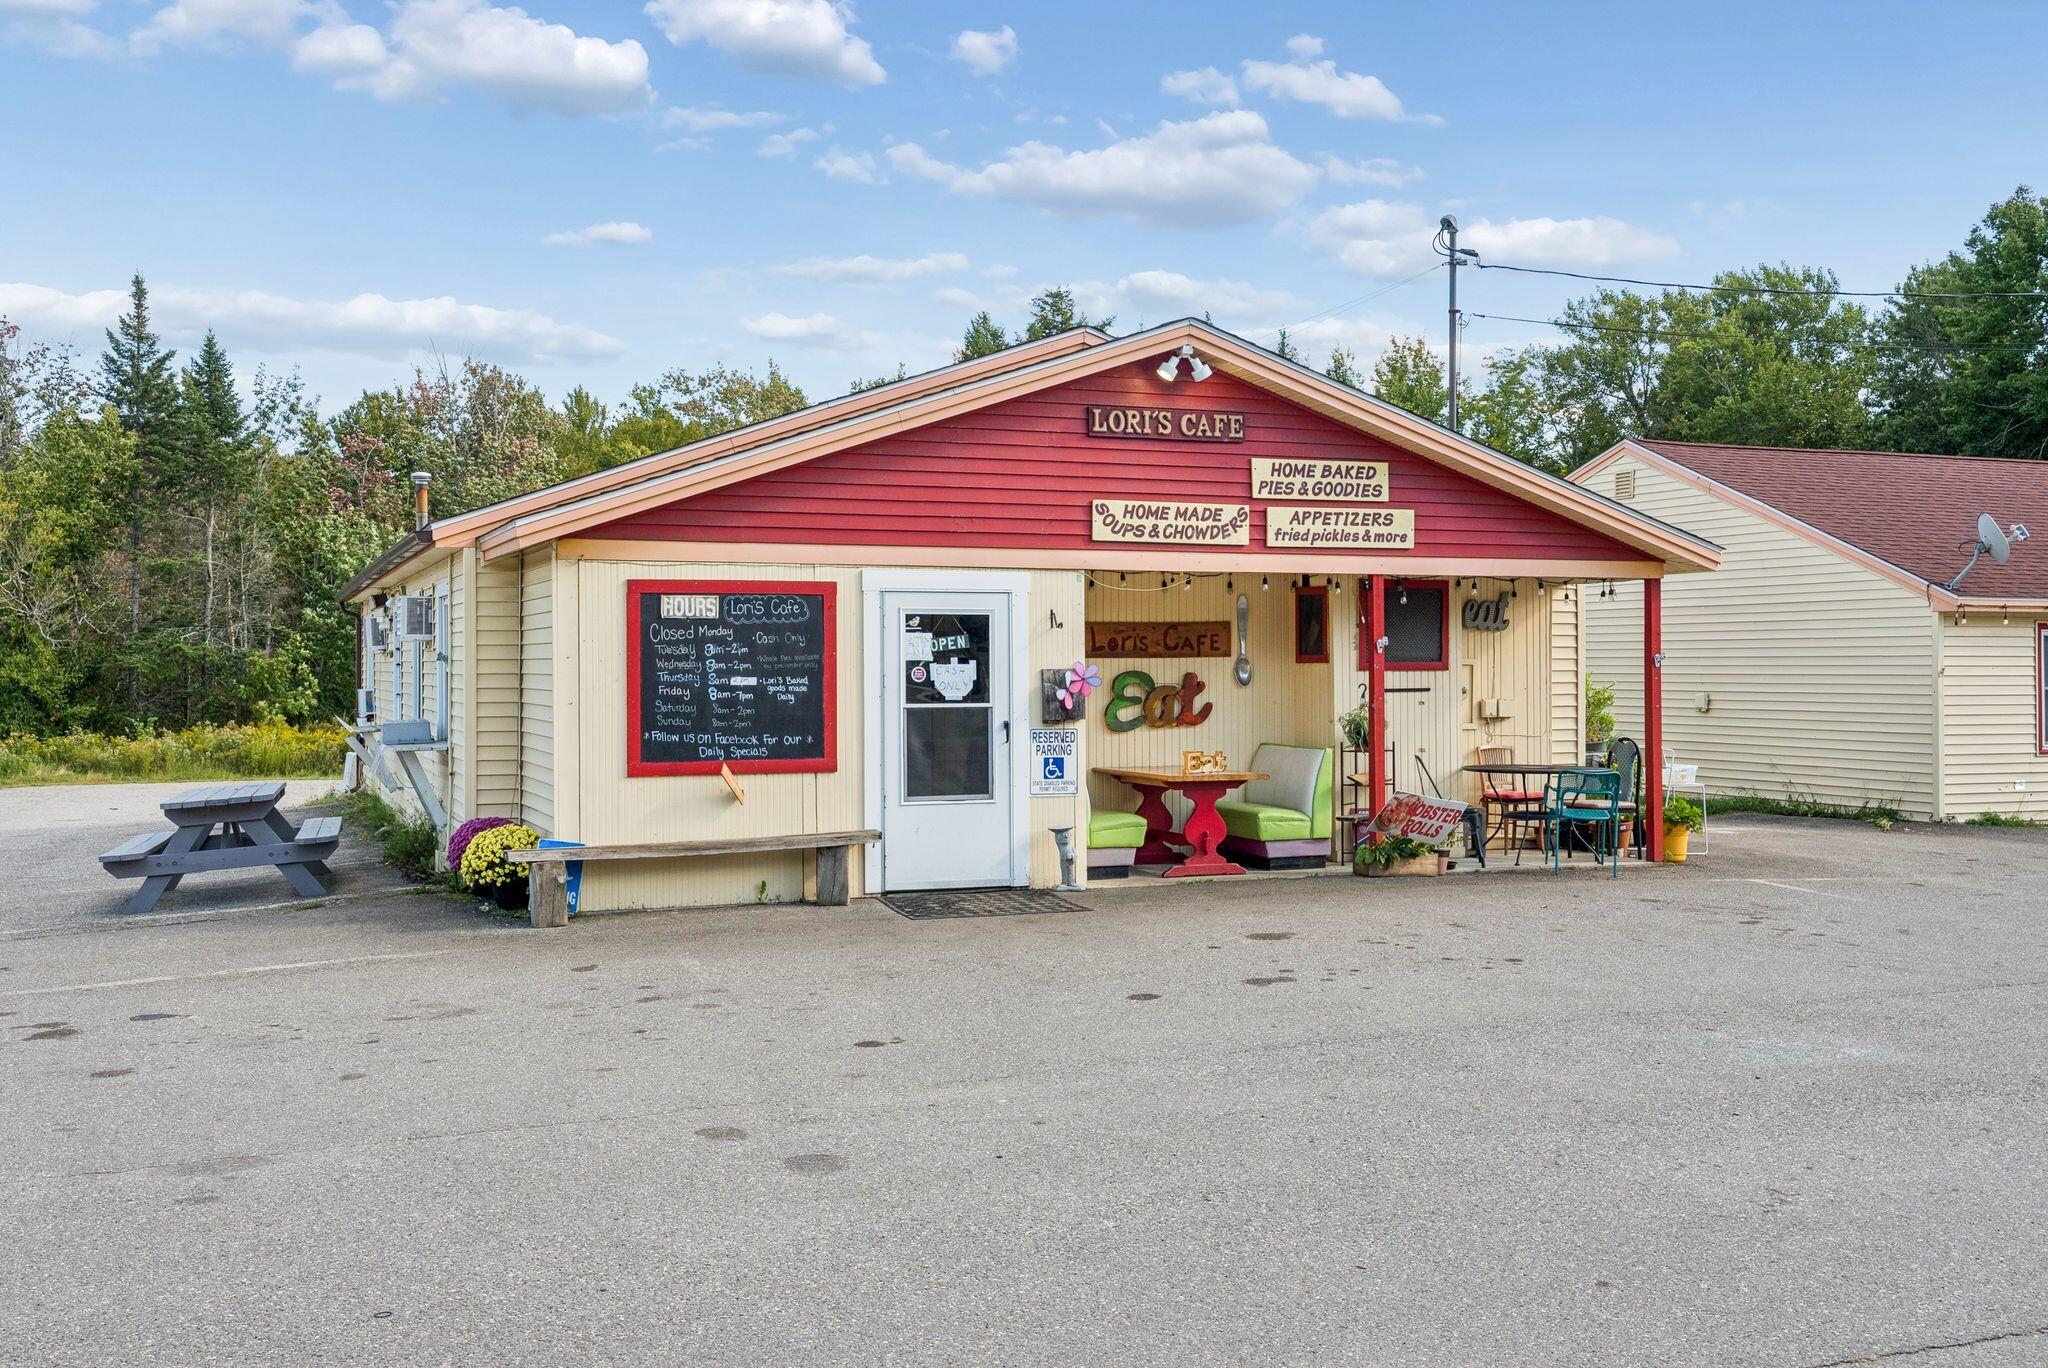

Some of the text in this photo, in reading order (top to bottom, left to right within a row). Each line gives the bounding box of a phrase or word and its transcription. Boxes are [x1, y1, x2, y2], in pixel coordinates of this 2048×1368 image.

[1092, 408, 1244, 438] LORI'S CAFE
[1271, 462, 1377, 480] HOME BAKED
[1258, 480, 1383, 498] PIES & GOODIES
[1094, 502, 1249, 540] SOUPS & CHOWDERS
[1122, 504, 1224, 522] HOME MADE
[1289, 510, 1394, 527] APPETIZERS
[1274, 528, 1408, 545] fried pickles & more
[663, 597, 716, 617] HOURS
[771, 599, 801, 615] Cafe
[1462, 591, 1510, 631] eat
[650, 623, 734, 643] Closed Monday
[756, 631, 806, 647] Cash Only
[655, 644, 696, 659] Tuesday
[931, 635, 966, 652] OPEN
[656, 658, 702, 673] Wednesday
[936, 666, 966, 675] CASH
[657, 671, 701, 687] Thursday
[786, 676, 808, 685] Baked
[939, 681, 968, 691] ONLY
[658, 686, 690, 700] Friday
[767, 684, 786, 694] goods
[777, 693, 795, 704] Daily
[1105, 670, 1213, 733] Eat
[655, 700, 697, 716] Saturday
[656, 715, 691, 730] Sunday
[651, 731, 679, 742] Follow
[684, 733, 696, 743] us
[697, 734, 712, 744] on
[715, 732, 760, 745] Facebook
[1032, 731, 1076, 743] RESERVED
[699, 746, 724, 760] Daily
[1035, 744, 1072, 756] PARKING
[1401, 819, 1443, 838] ROLLS
